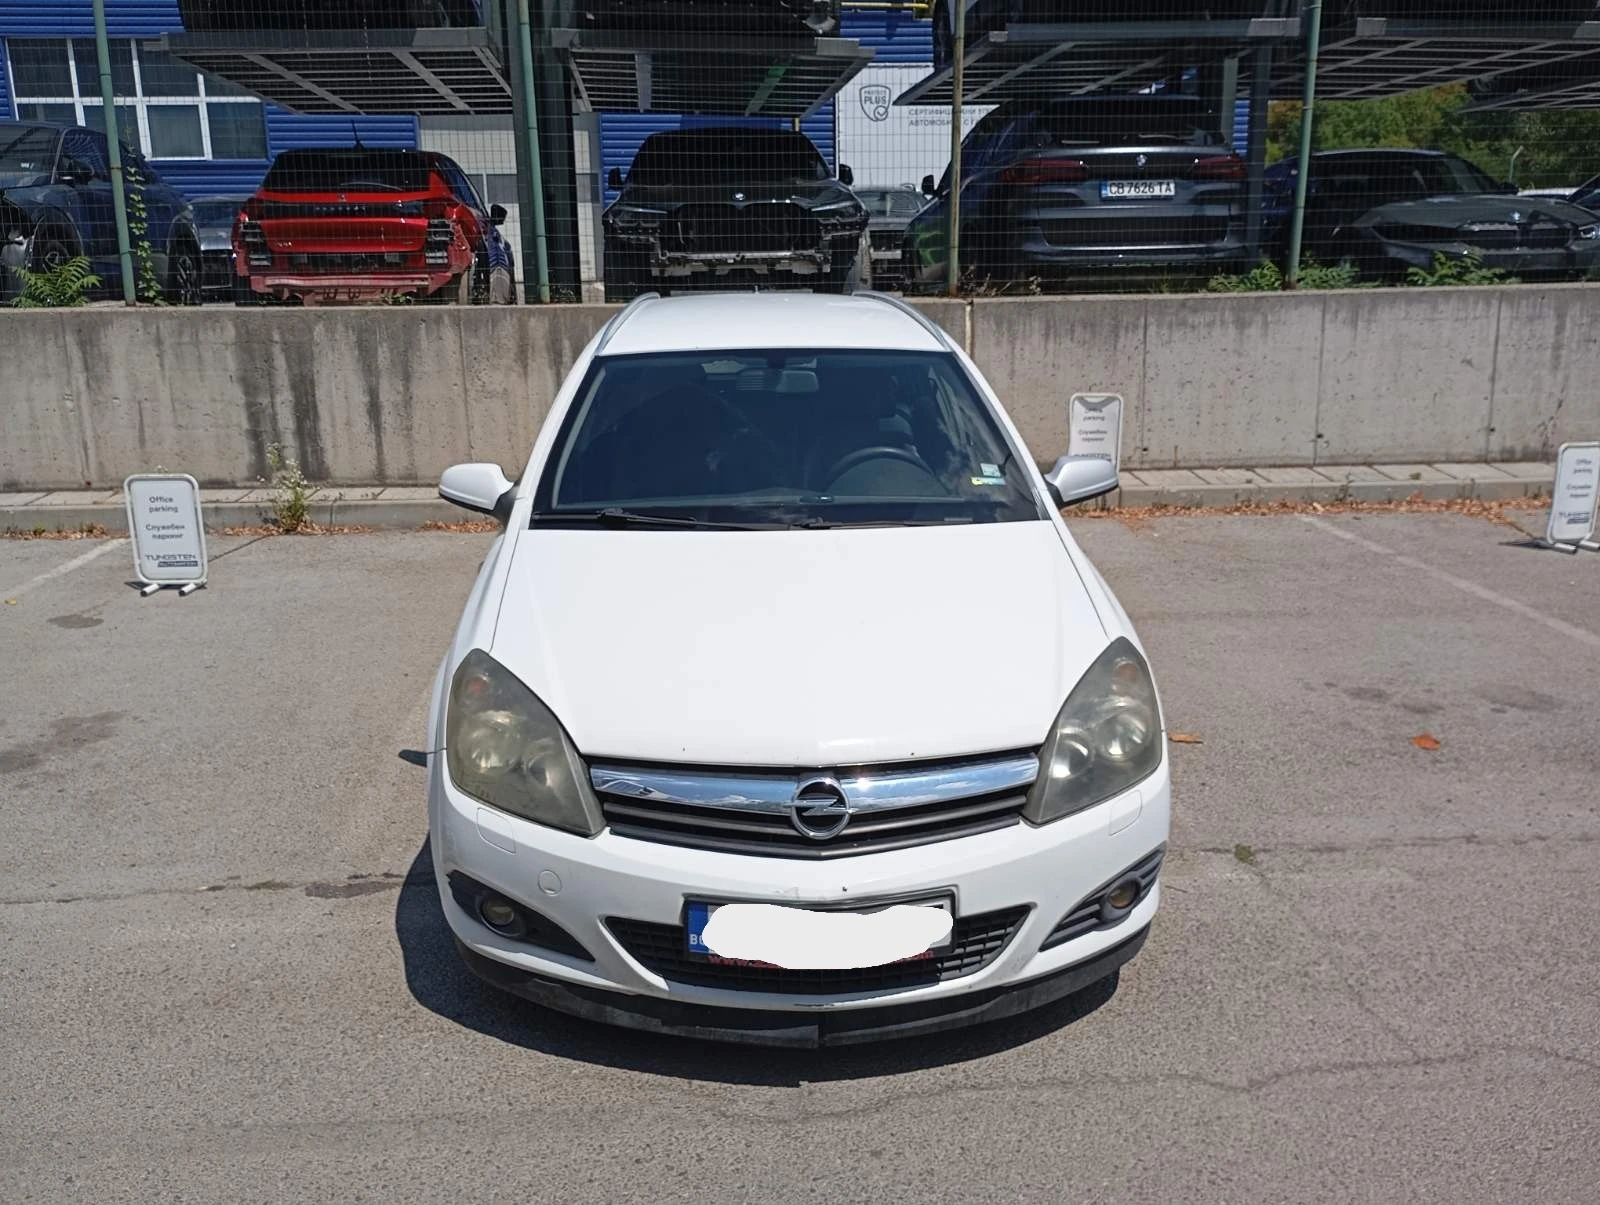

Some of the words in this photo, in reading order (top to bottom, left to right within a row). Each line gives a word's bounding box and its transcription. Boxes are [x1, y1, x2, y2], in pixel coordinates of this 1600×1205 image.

[864, 95, 887, 105] PLUS
[1110, 182, 1125, 195] CB
[1127, 182, 1155, 194] 7626
[1157, 182, 1172, 193] TA
[149, 505, 178, 513] parking
